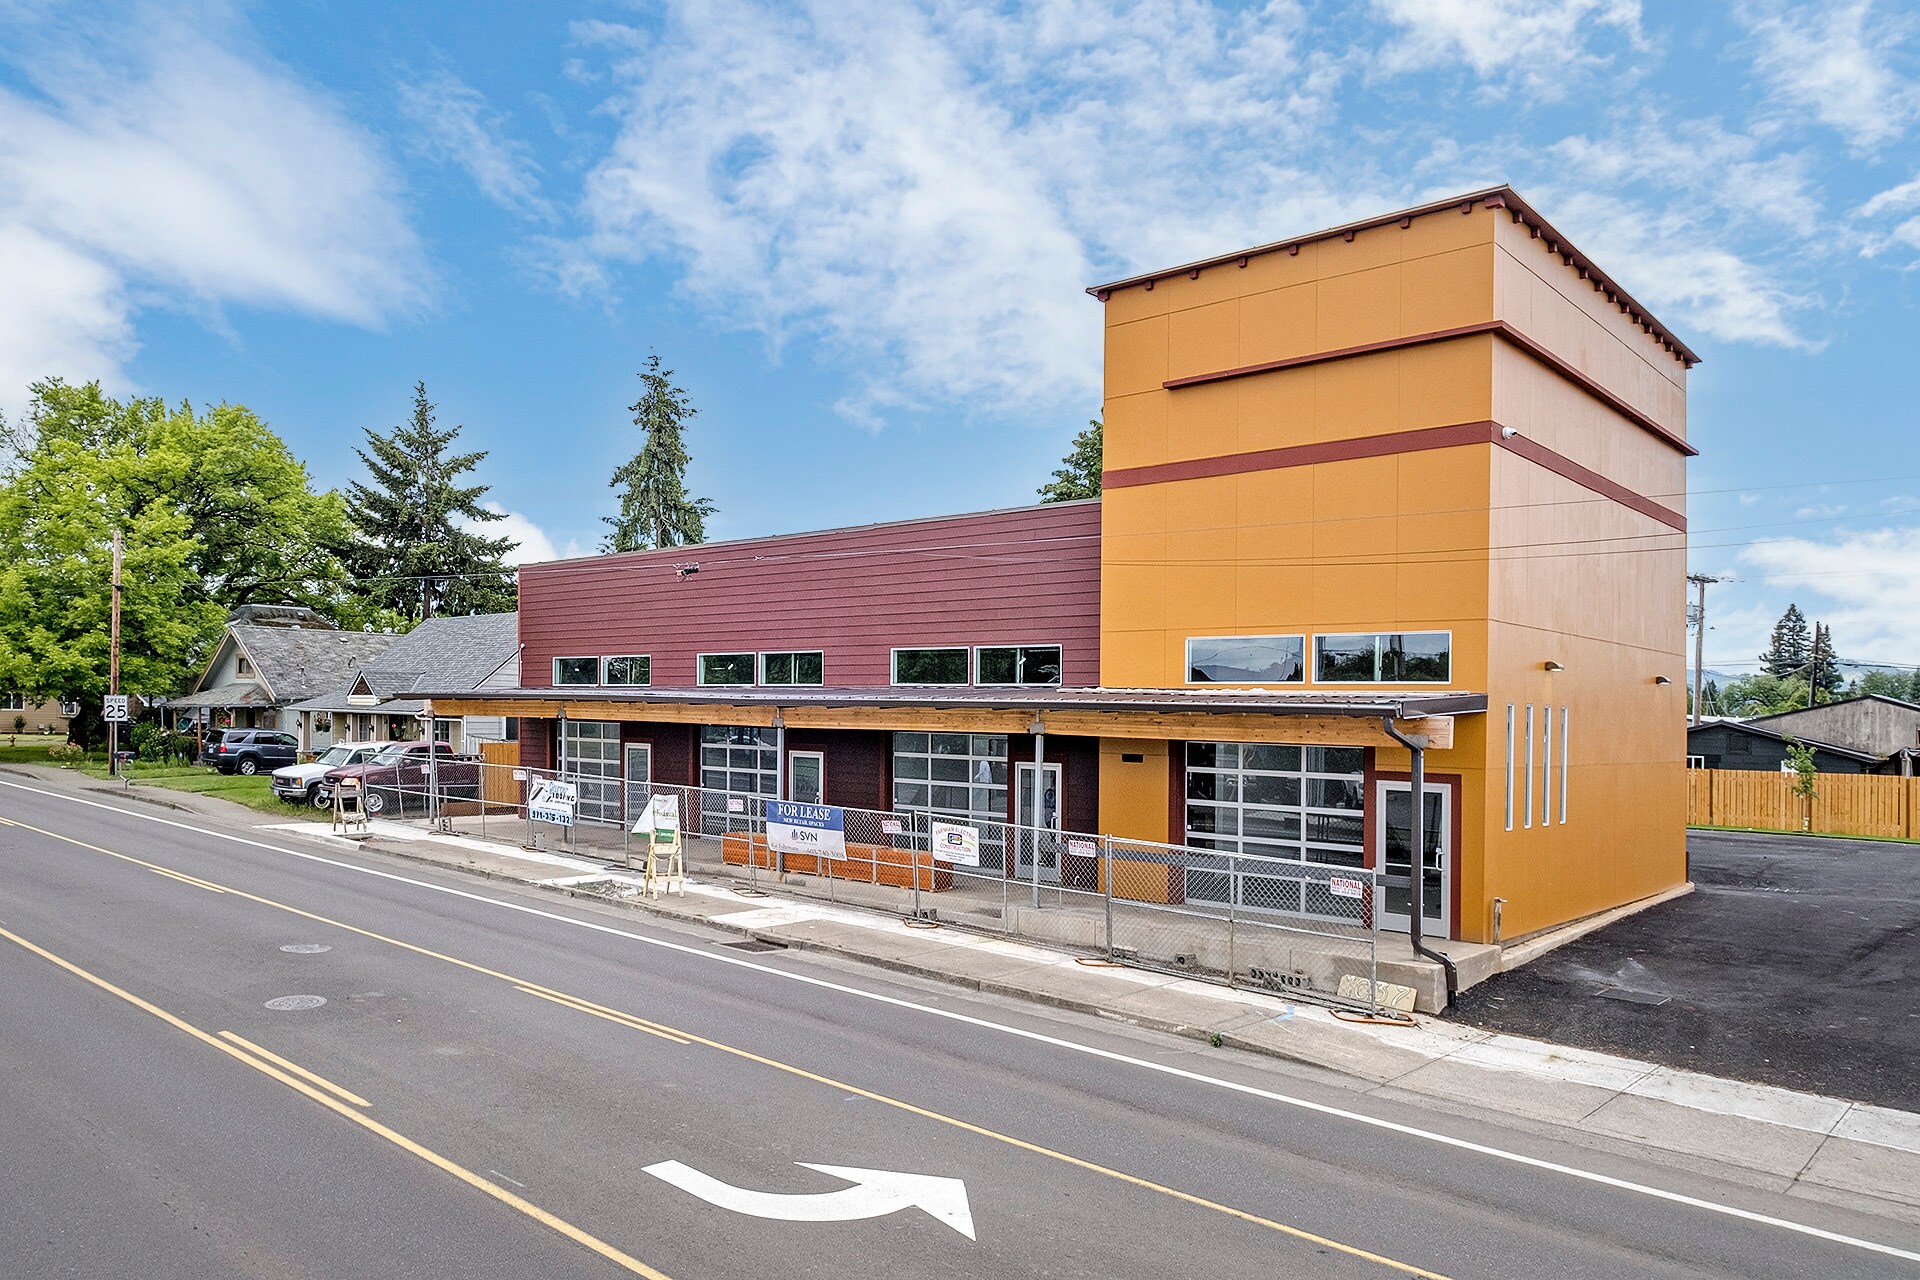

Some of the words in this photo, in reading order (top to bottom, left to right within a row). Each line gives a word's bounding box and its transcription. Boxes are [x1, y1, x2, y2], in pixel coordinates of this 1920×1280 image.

[106, 704, 126, 718] 25
[777, 803, 798, 817] FOR
[800, 805, 831, 820] LEASE
[800, 831, 818, 842] SVN
[955, 826, 976, 841] ELECTRIC
[940, 843, 972, 853] CONSTRUCTION
[1070, 841, 1095, 850] NATIONAL
[1332, 879, 1361, 890] NATIONAL
